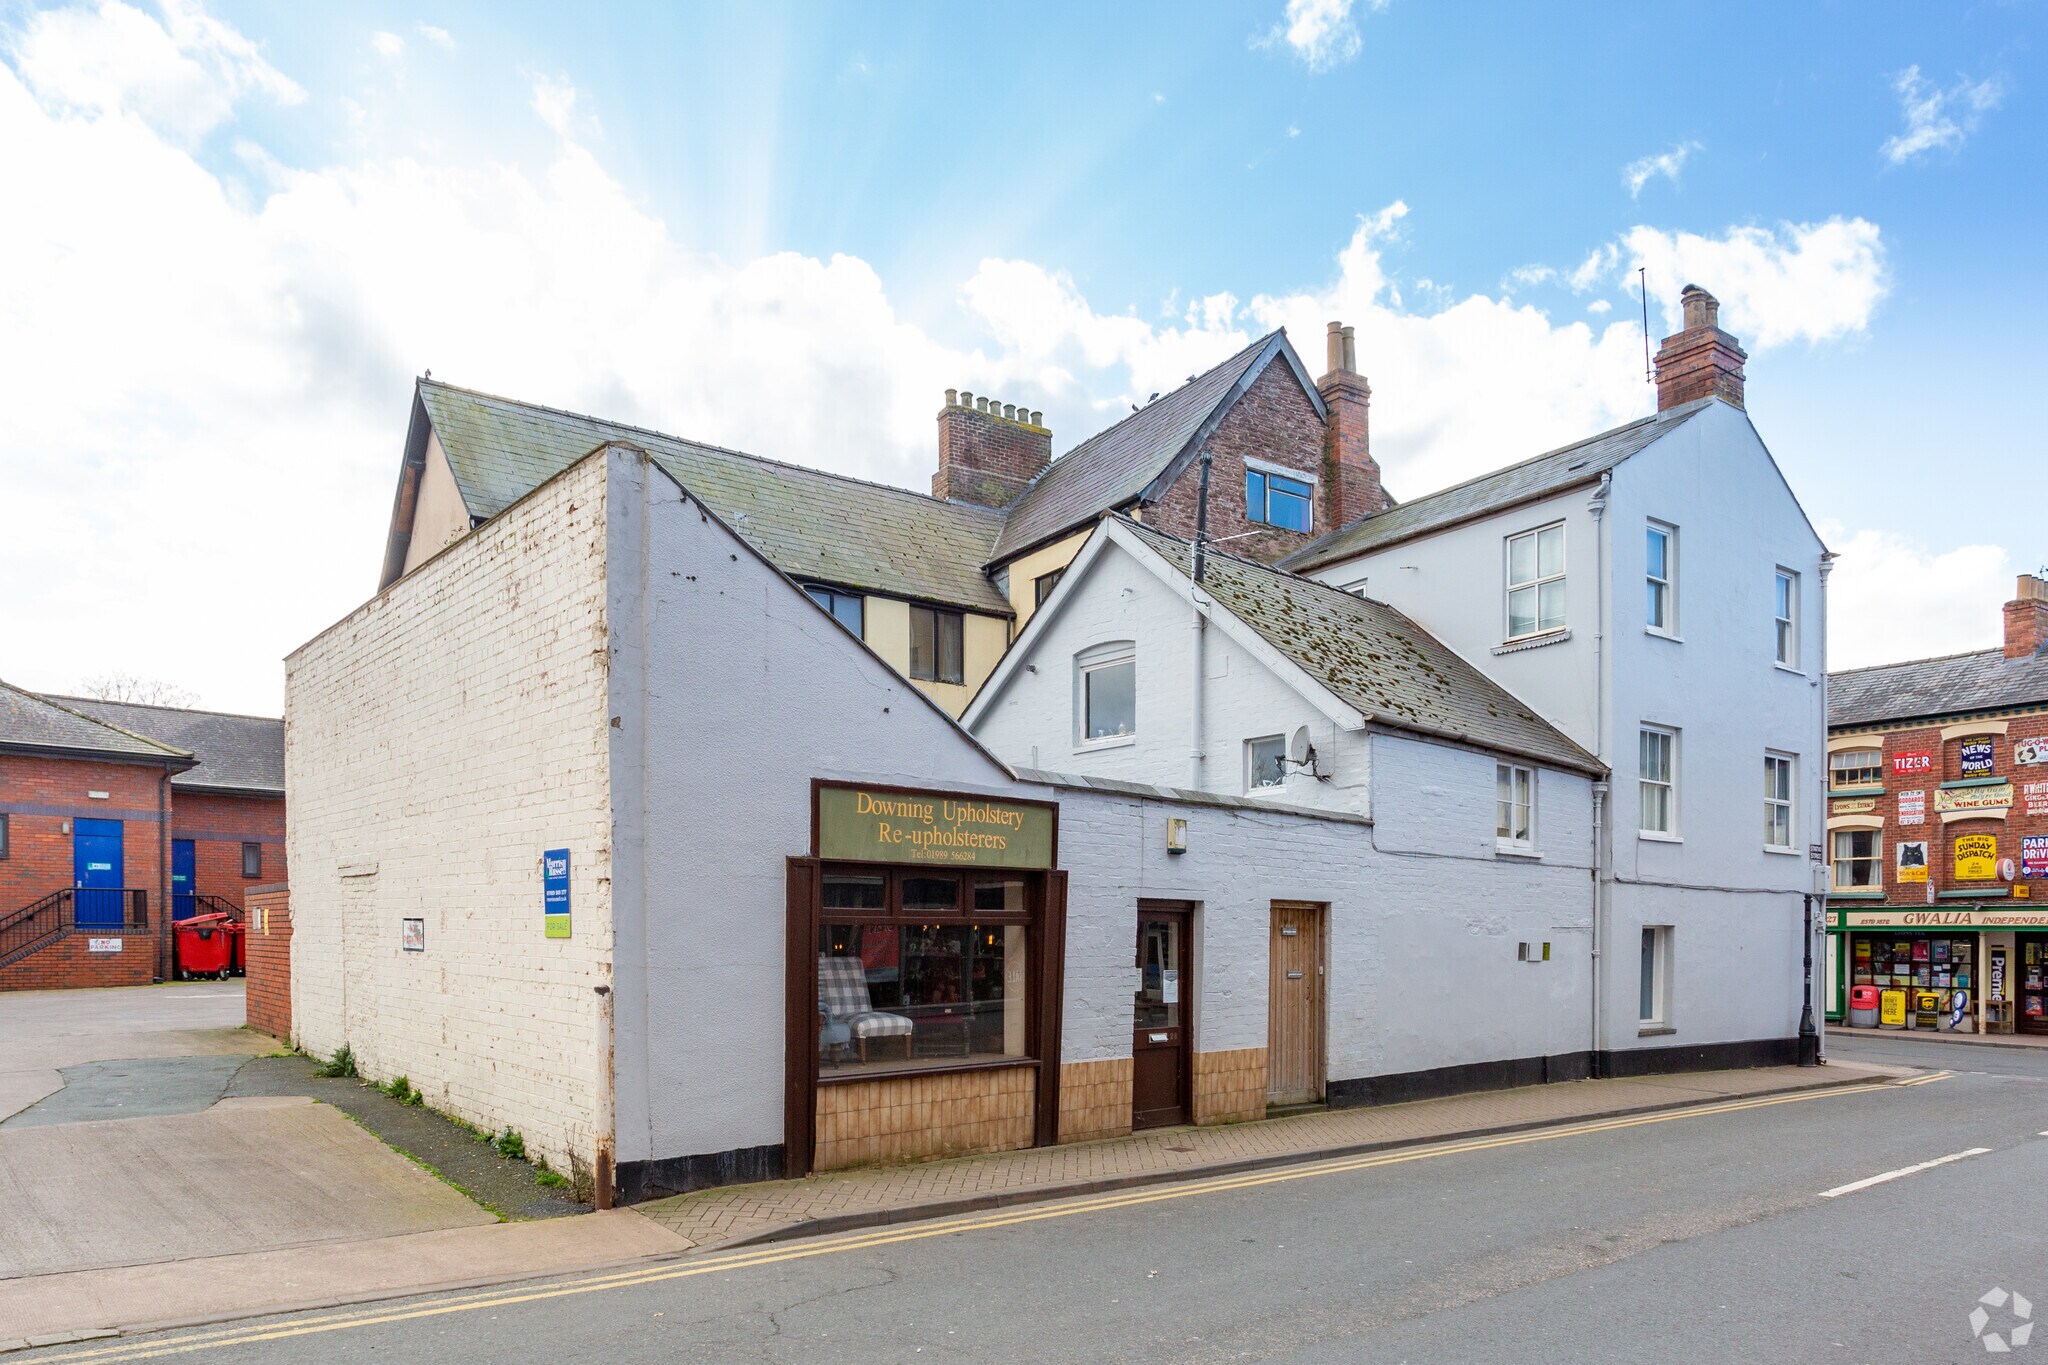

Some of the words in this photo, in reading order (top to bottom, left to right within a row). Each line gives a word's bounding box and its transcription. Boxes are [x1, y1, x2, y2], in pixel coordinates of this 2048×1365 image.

[1962, 744, 1992, 756] NEWS
[1894, 756, 1930, 769] TIZER
[1961, 759, 1993, 771] WORLD
[1982, 798, 2009, 806] GUMS
[857, 793, 933, 824] Downing
[943, 801, 1024, 831] Upholstery
[1958, 842, 1992, 852] SUNDAY
[1957, 850, 1995, 861] DISPATCH
[1903, 913, 1972, 925] GWALIA
